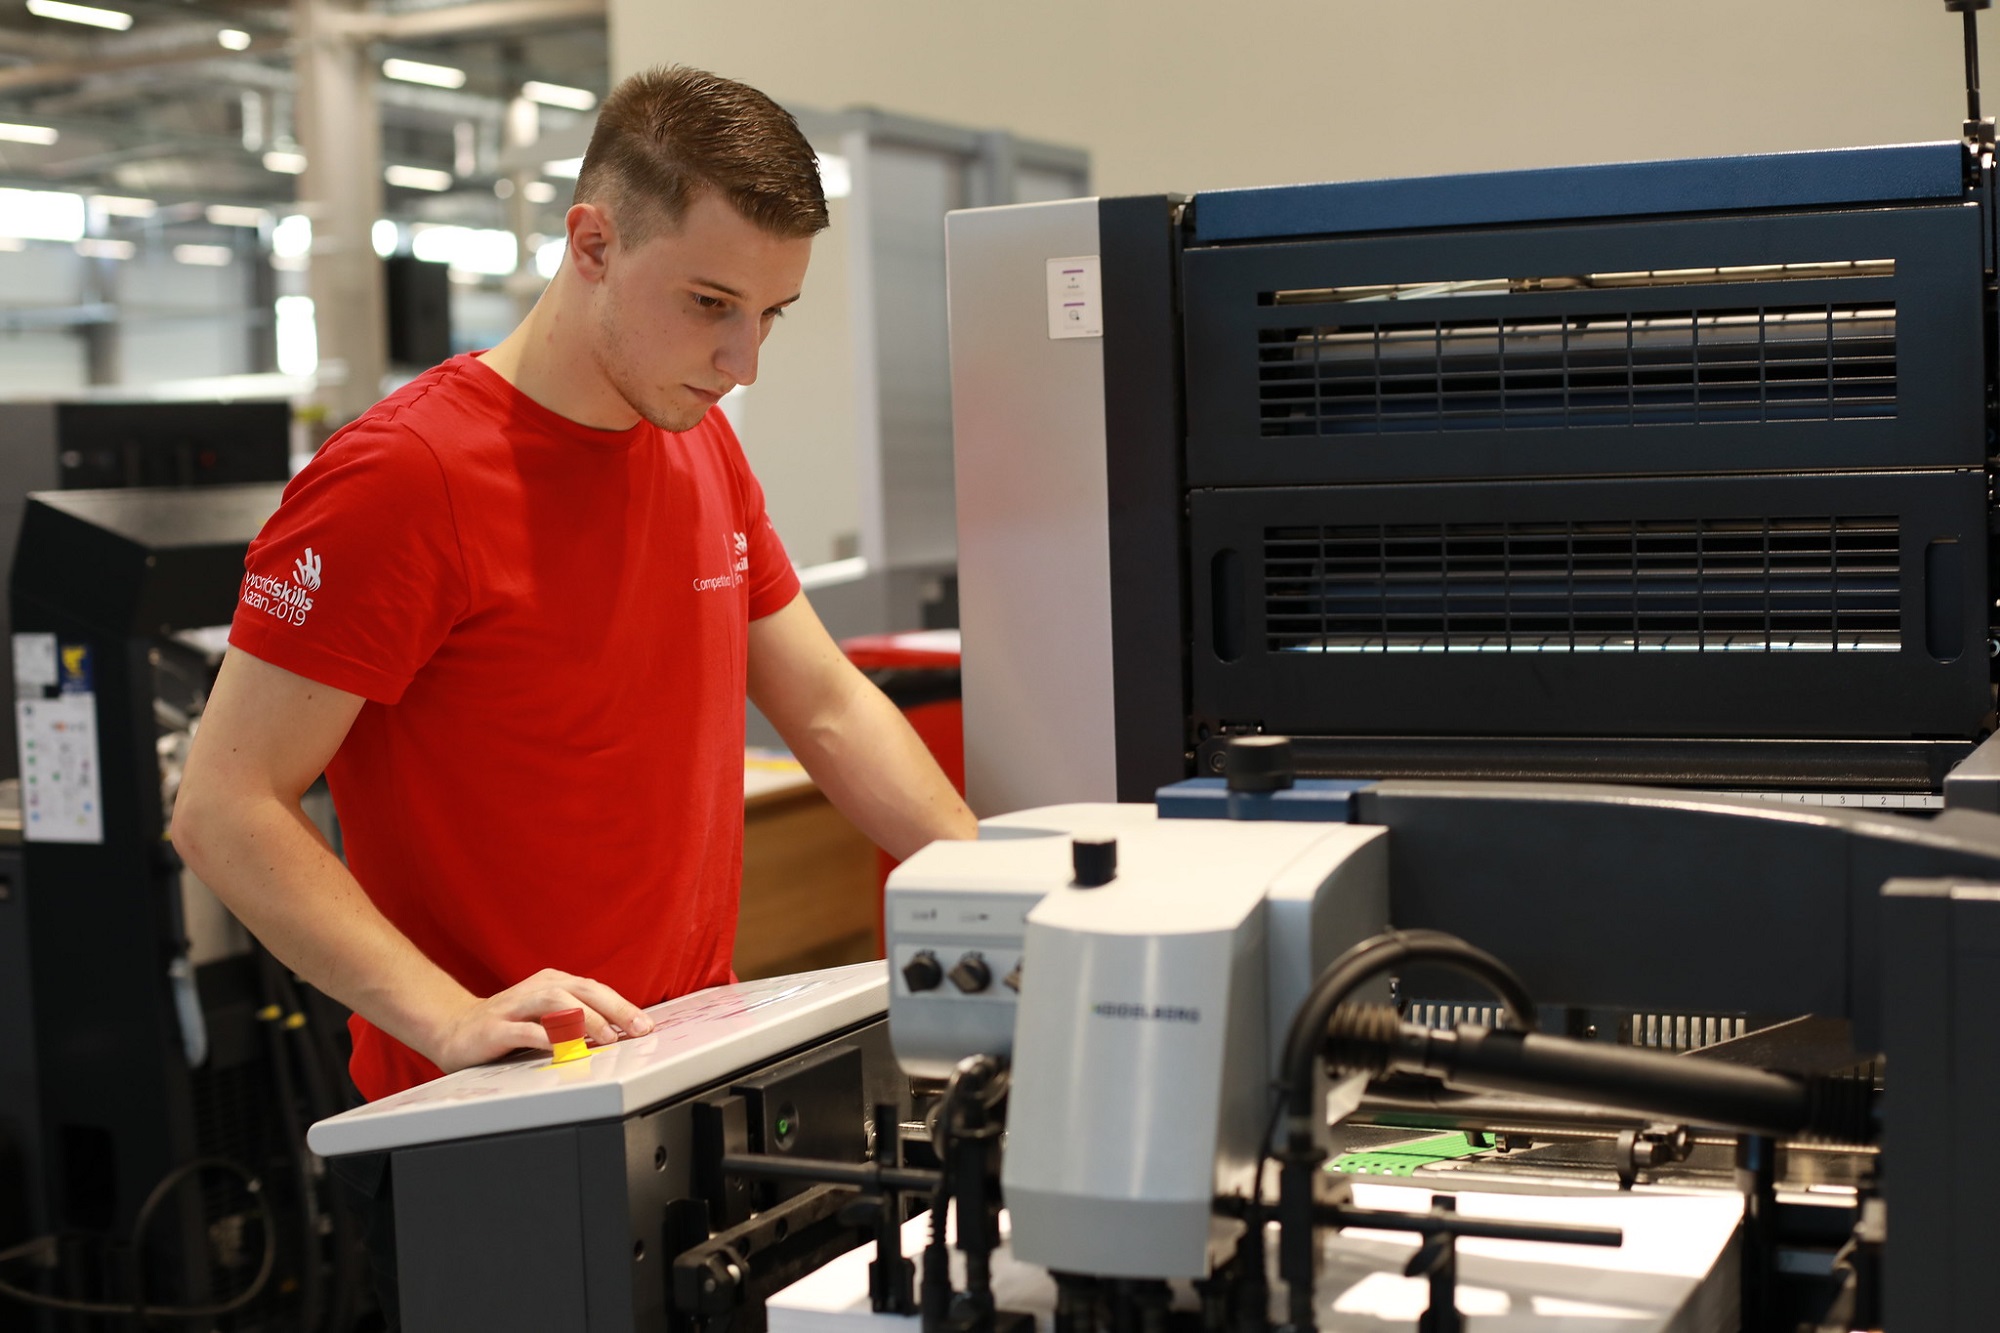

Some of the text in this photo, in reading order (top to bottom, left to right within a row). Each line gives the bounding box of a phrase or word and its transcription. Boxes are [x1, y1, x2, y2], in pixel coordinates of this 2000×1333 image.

[245, 571, 314, 611] worldskills
[1799, 795, 1805, 804] 4
[1840, 796, 1846, 805] 3
[1881, 796, 1887, 806] 2
